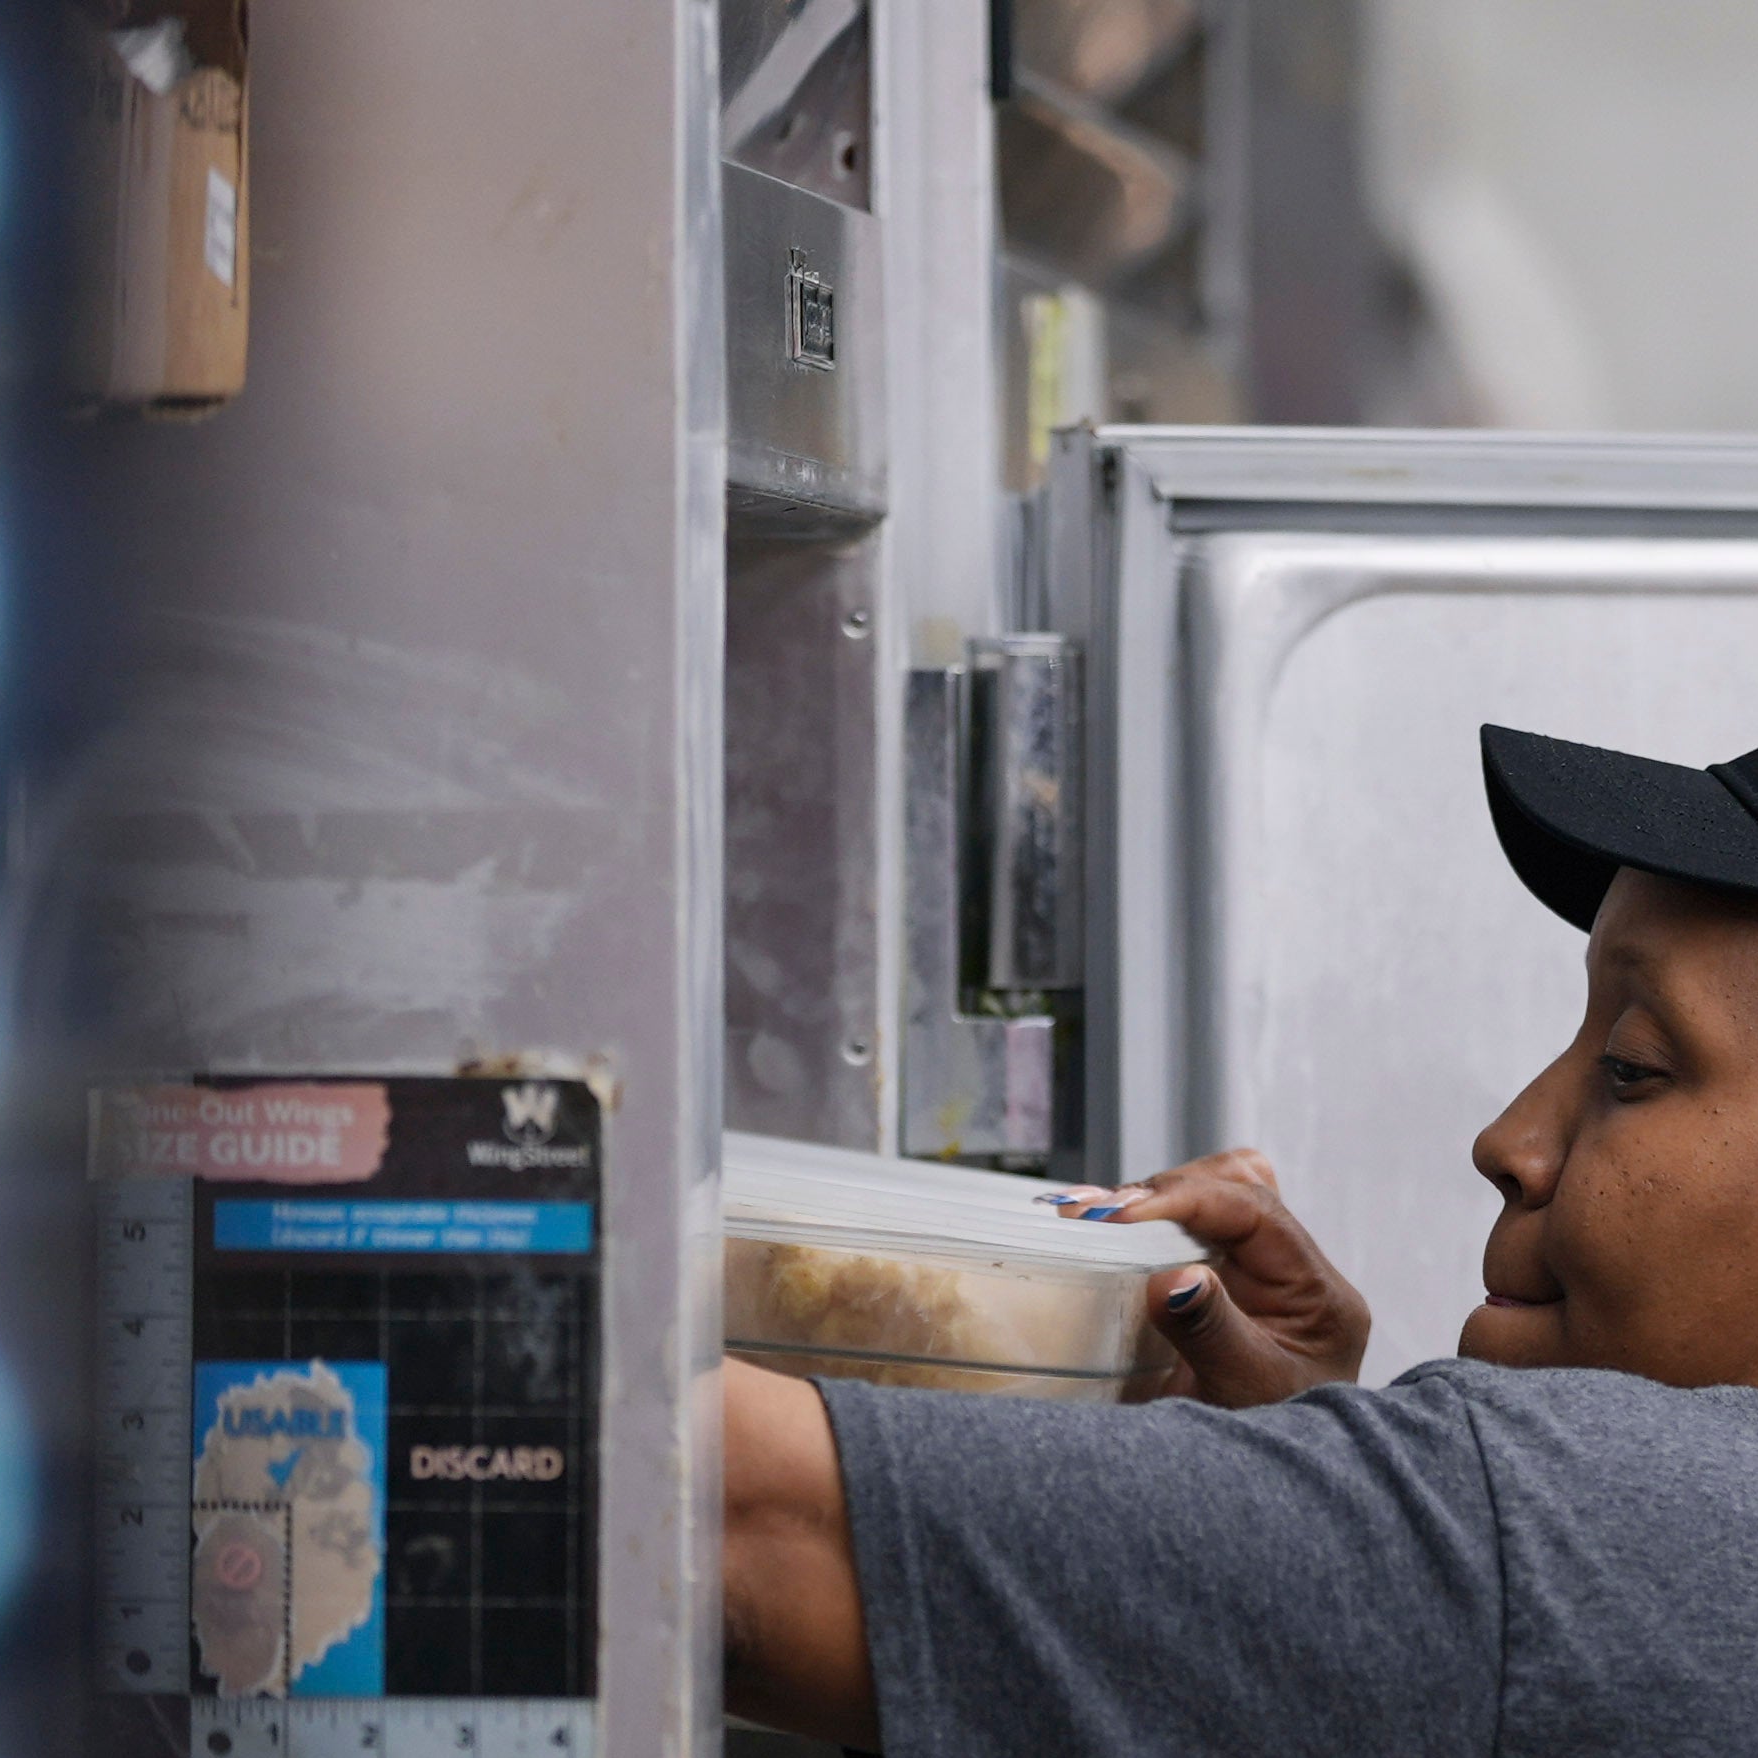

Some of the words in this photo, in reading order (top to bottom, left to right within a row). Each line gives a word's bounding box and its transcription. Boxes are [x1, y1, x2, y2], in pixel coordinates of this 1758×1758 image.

[264, 1098, 355, 1131] Wings
[208, 1131, 342, 1167] GUIDE
[223, 1407, 346, 1439] USABLE
[410, 1445, 564, 1481] DISCARD
